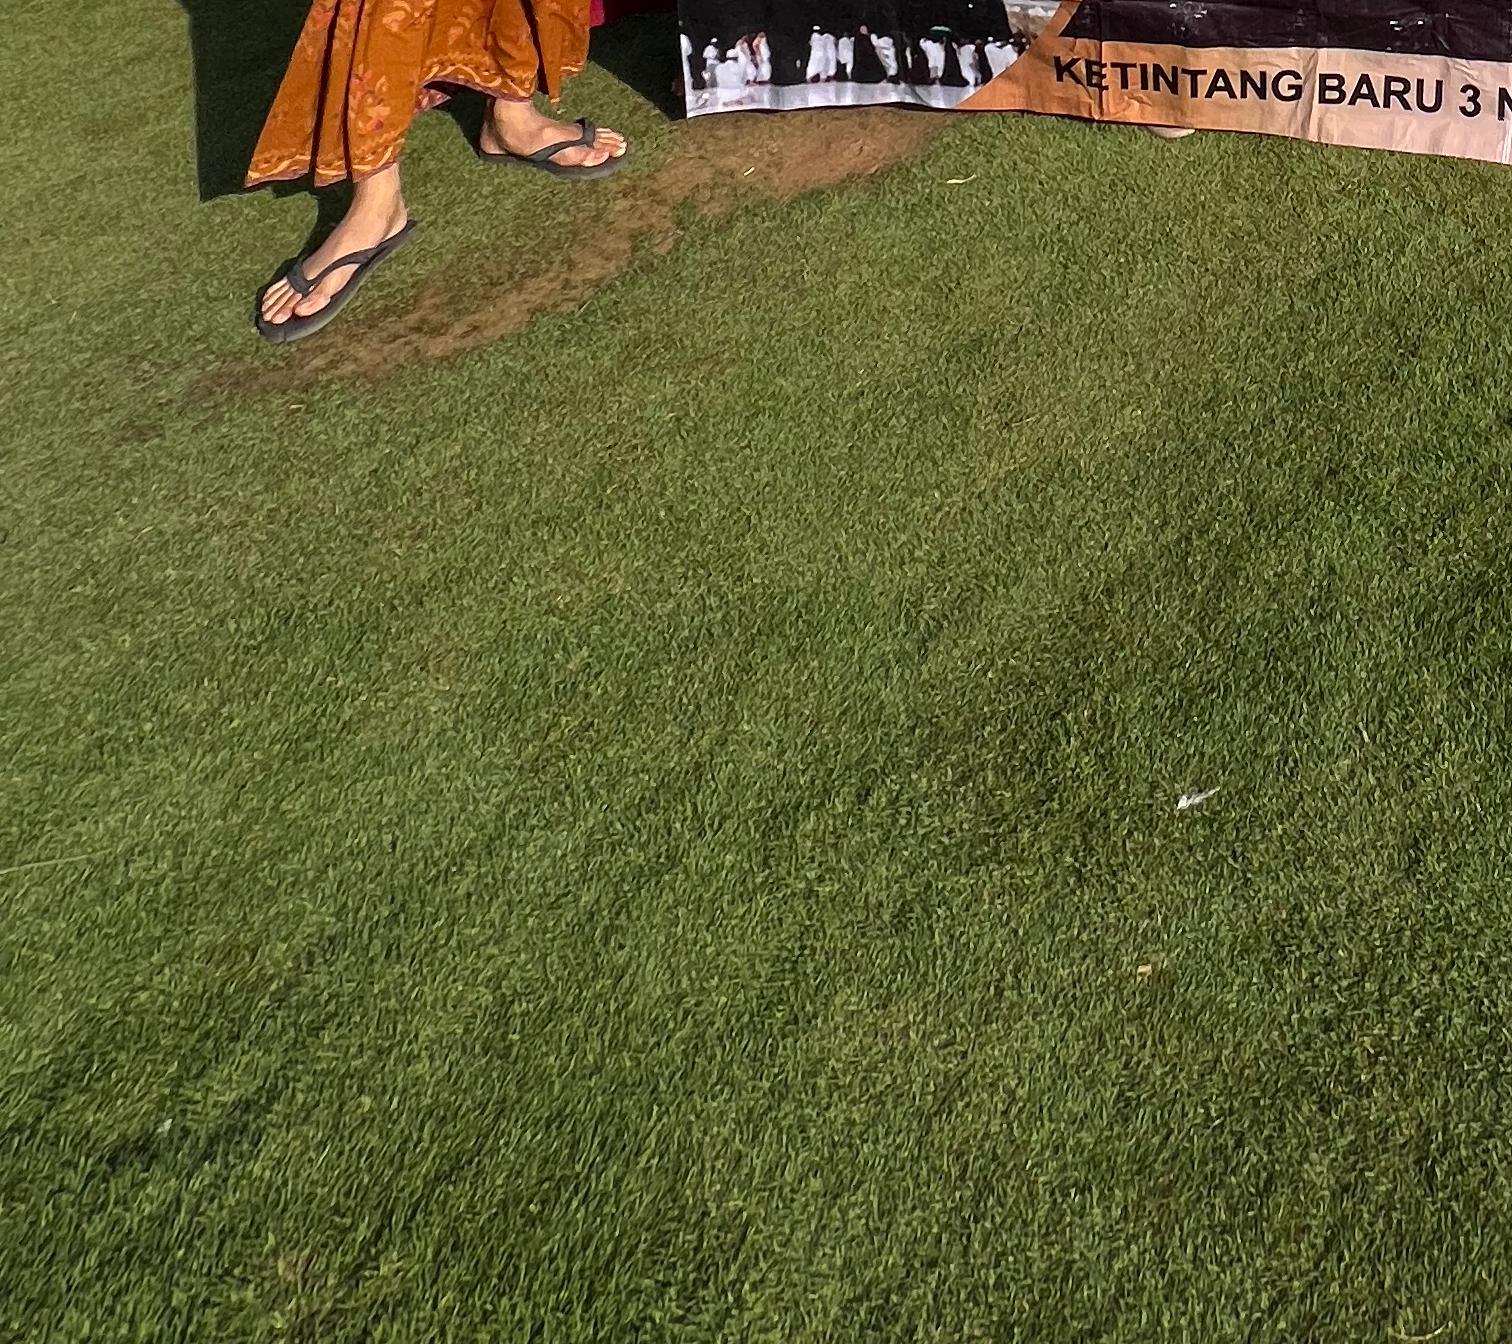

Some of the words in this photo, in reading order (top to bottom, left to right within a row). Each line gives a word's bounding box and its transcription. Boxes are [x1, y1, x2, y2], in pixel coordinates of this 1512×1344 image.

[1053, 54, 1304, 102] KETINTANG
[1317, 71, 1445, 114] BARU
[1457, 83, 1483, 119] 3
